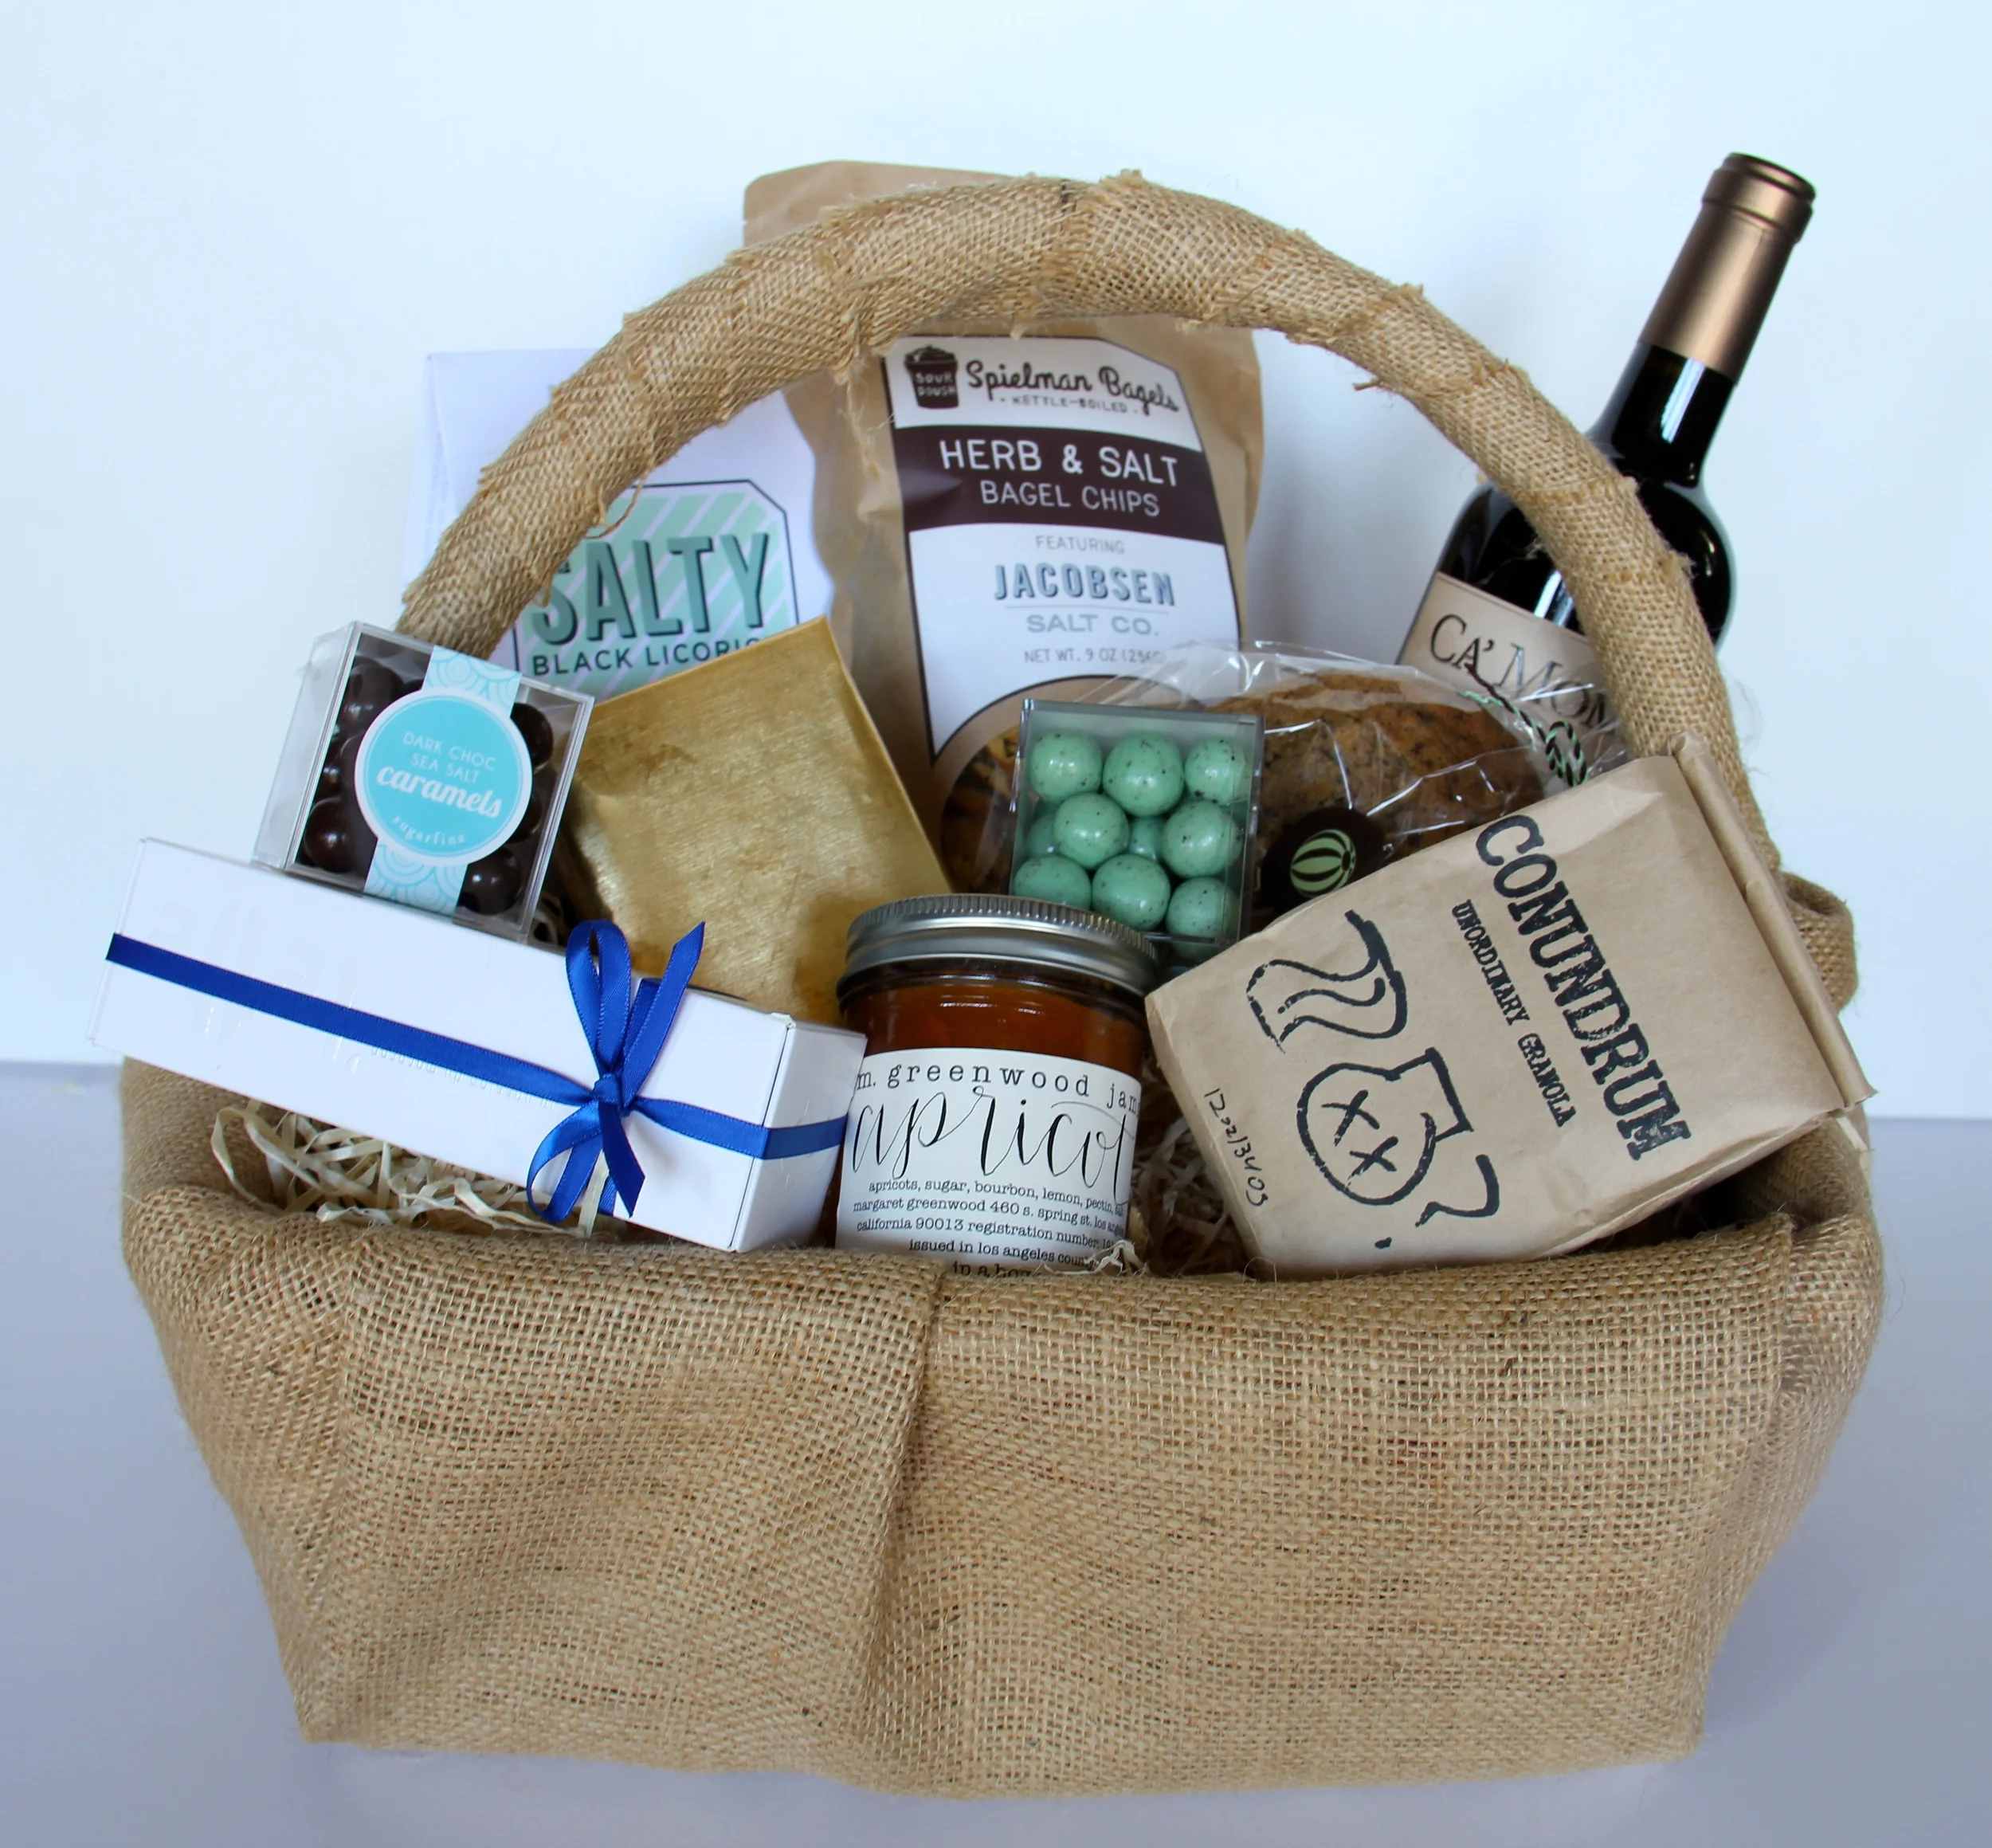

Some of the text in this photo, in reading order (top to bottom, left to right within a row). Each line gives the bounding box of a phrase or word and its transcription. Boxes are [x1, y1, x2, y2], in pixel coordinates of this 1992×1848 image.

[965, 359, 1180, 416] Spielman Bagels
[1012, 394, 1127, 414] KETTLE-BOILED
[939, 439, 1178, 487] HERB & SALT
[980, 480, 1159, 517] BAGEL CHIPS
[1036, 534, 1126, 555] FEATURING
[531, 532, 770, 646] SALTY
[993, 563, 1176, 606] JACOBSEN
[1025, 613, 1159, 636] SALT CO.
[532, 648, 633, 677] BLACK
[1024, 648, 1050, 663] NET
[1055, 647, 1081, 663] WT.
[1085, 647, 1094, 662] 9
[1099, 647, 1118, 662] OZ
[402, 731, 496, 771] DARK CHOC
[410, 752, 480, 784] SEA SALT
[376, 765, 503, 819] caramels
[1450, 898, 1531, 1028] UNORDINARY
[1476, 814, 1692, 1161] CONUNDRUM
[856, 1071, 876, 1091] m.
[887, 1063, 1089, 1098] greenwood
[1516, 1032, 1577, 1128] GRANOLA
[852, 1085, 1135, 1203] apricot
[853, 1197, 904, 1213] margaret
[907, 1197, 986, 1212] greenwood
[989, 1200, 1020, 1215] 460
[1022, 1206, 1033, 1217] s.
[1037, 1208, 1078, 1226] spring
[1080, 1214, 1092, 1227] st.
[1094, 1215, 1107, 1230] los
[868, 1179, 922, 1194] apricots,
[924, 1179, 971, 1195] sugar,
[974, 1180, 1038, 1200] bourbon,
[1041, 1187, 1083, 1208] lemon,
[1085, 1197, 1114, 1214] pectin,
[857, 1217, 912, 1232] california
[916, 1217, 964, 1231] 90013
[967, 1221, 1053, 1242] registration
[908, 1238, 955, 1252] issued
[959, 1240, 974, 1254] in
[978, 1241, 999, 1256] los
[1002, 1246, 1056, 1263] angeles
[952, 1260, 971, 1276] in
[978, 1265, 990, 1277] a
